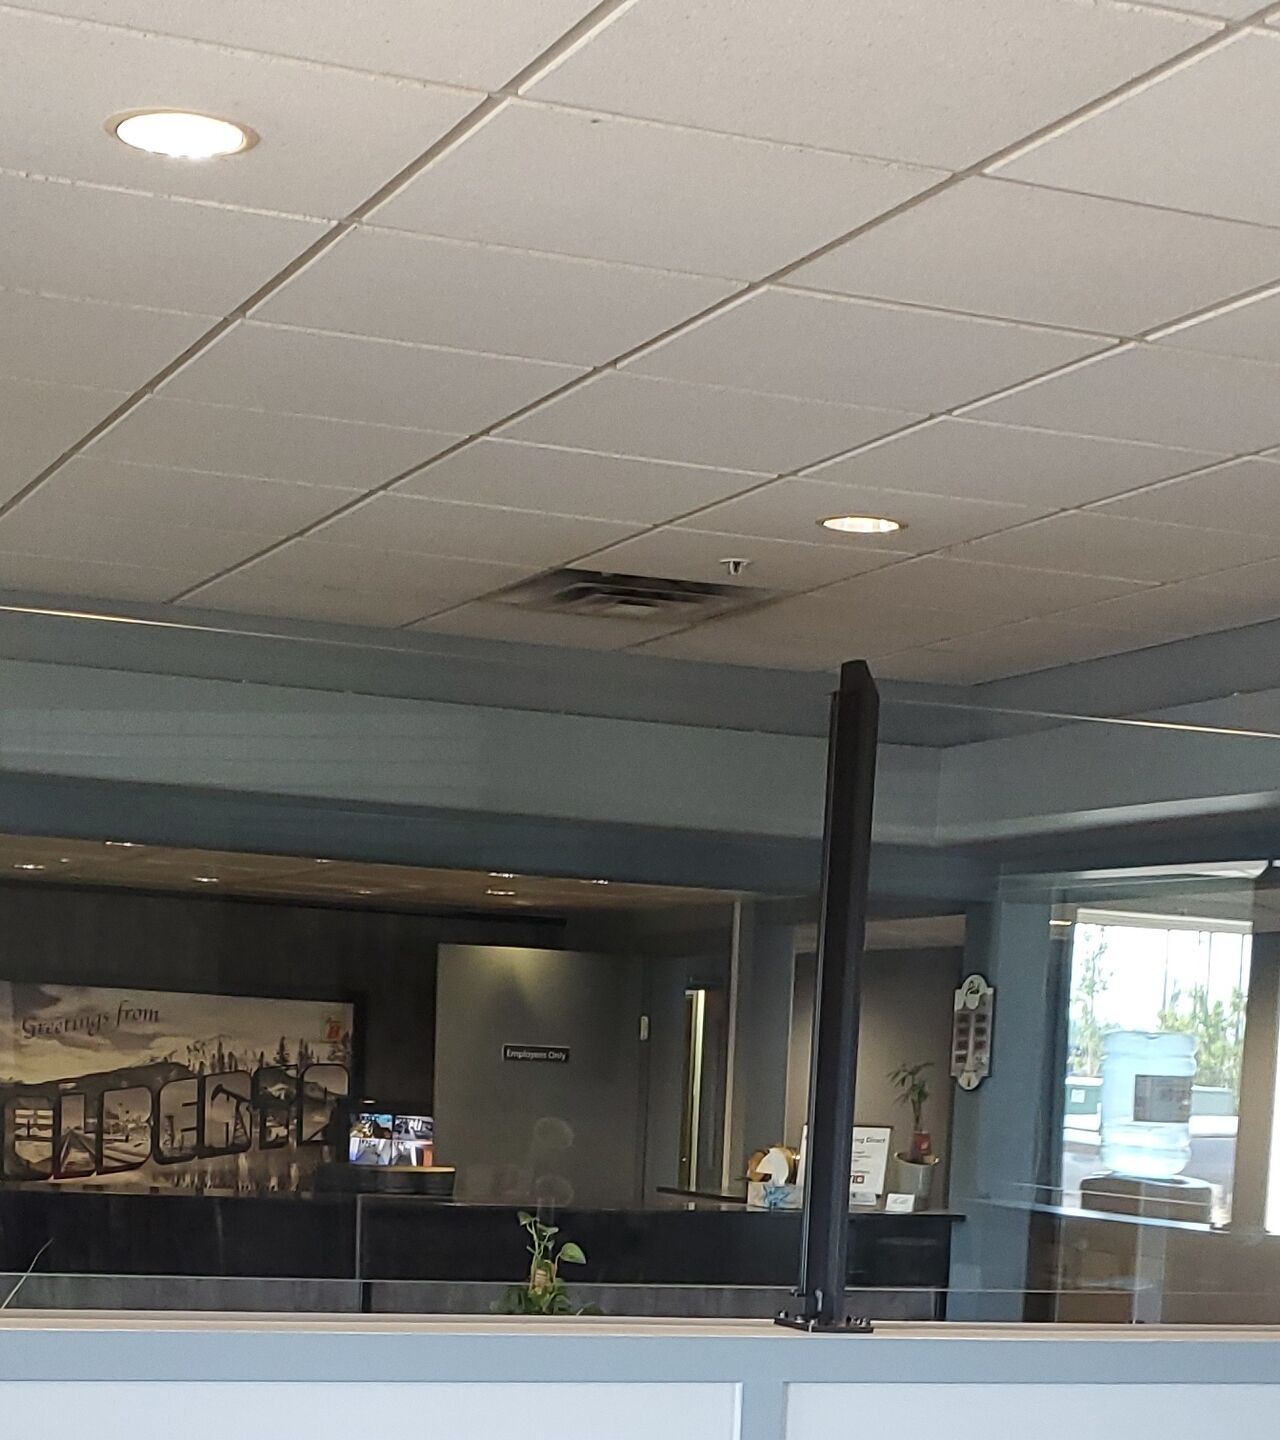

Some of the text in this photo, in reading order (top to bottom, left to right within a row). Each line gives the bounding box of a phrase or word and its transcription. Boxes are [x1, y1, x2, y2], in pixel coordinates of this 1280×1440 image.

[22, 1000, 160, 1039] Greetings from
[548, 1051, 567, 1061] Only
